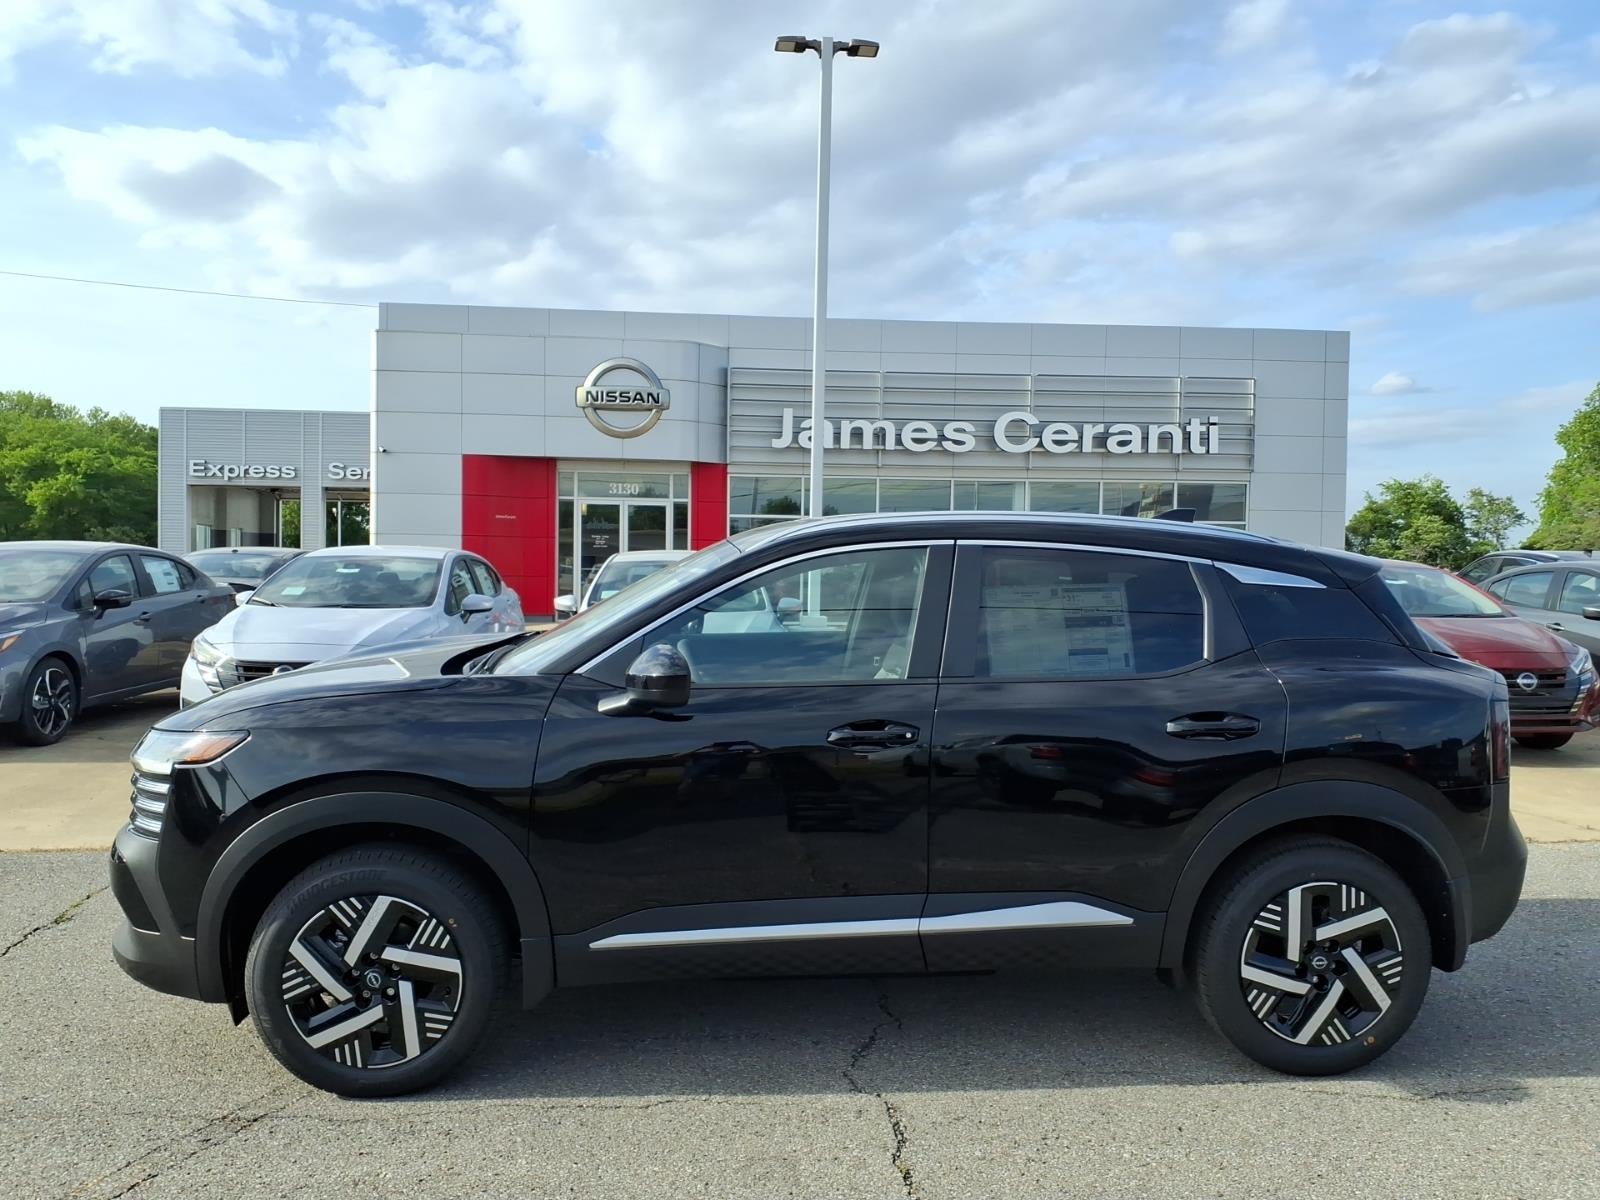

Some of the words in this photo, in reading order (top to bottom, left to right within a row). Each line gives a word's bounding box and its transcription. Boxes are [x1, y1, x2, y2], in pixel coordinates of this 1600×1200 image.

[586, 391, 660, 405] NISSAN
[771, 408, 976, 452] James
[993, 411, 1219, 454] Ceranti
[190, 460, 297, 481] Express
[609, 482, 639, 496] 3130
